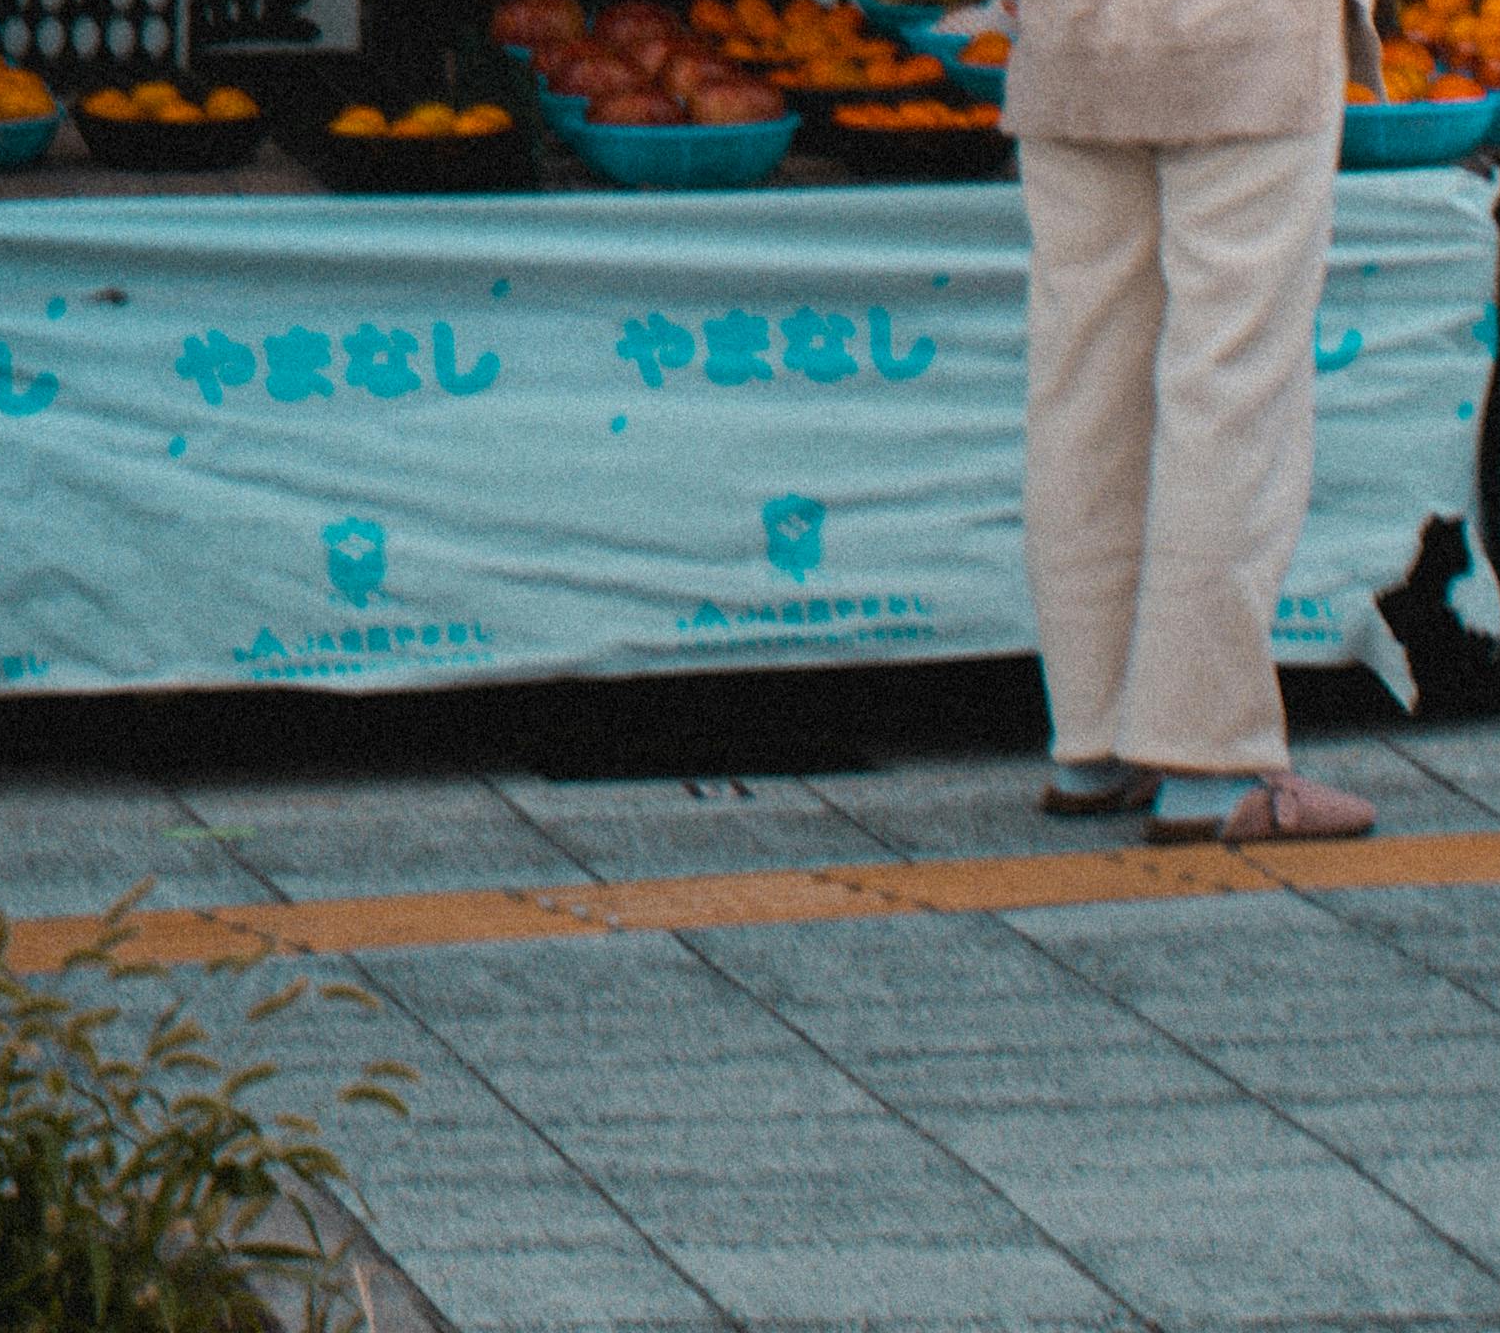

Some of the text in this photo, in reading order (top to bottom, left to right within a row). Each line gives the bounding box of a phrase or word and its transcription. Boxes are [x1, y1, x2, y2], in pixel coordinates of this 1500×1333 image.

[173, 319, 501, 407] やまなし
[614, 303, 938, 389] やまなし
